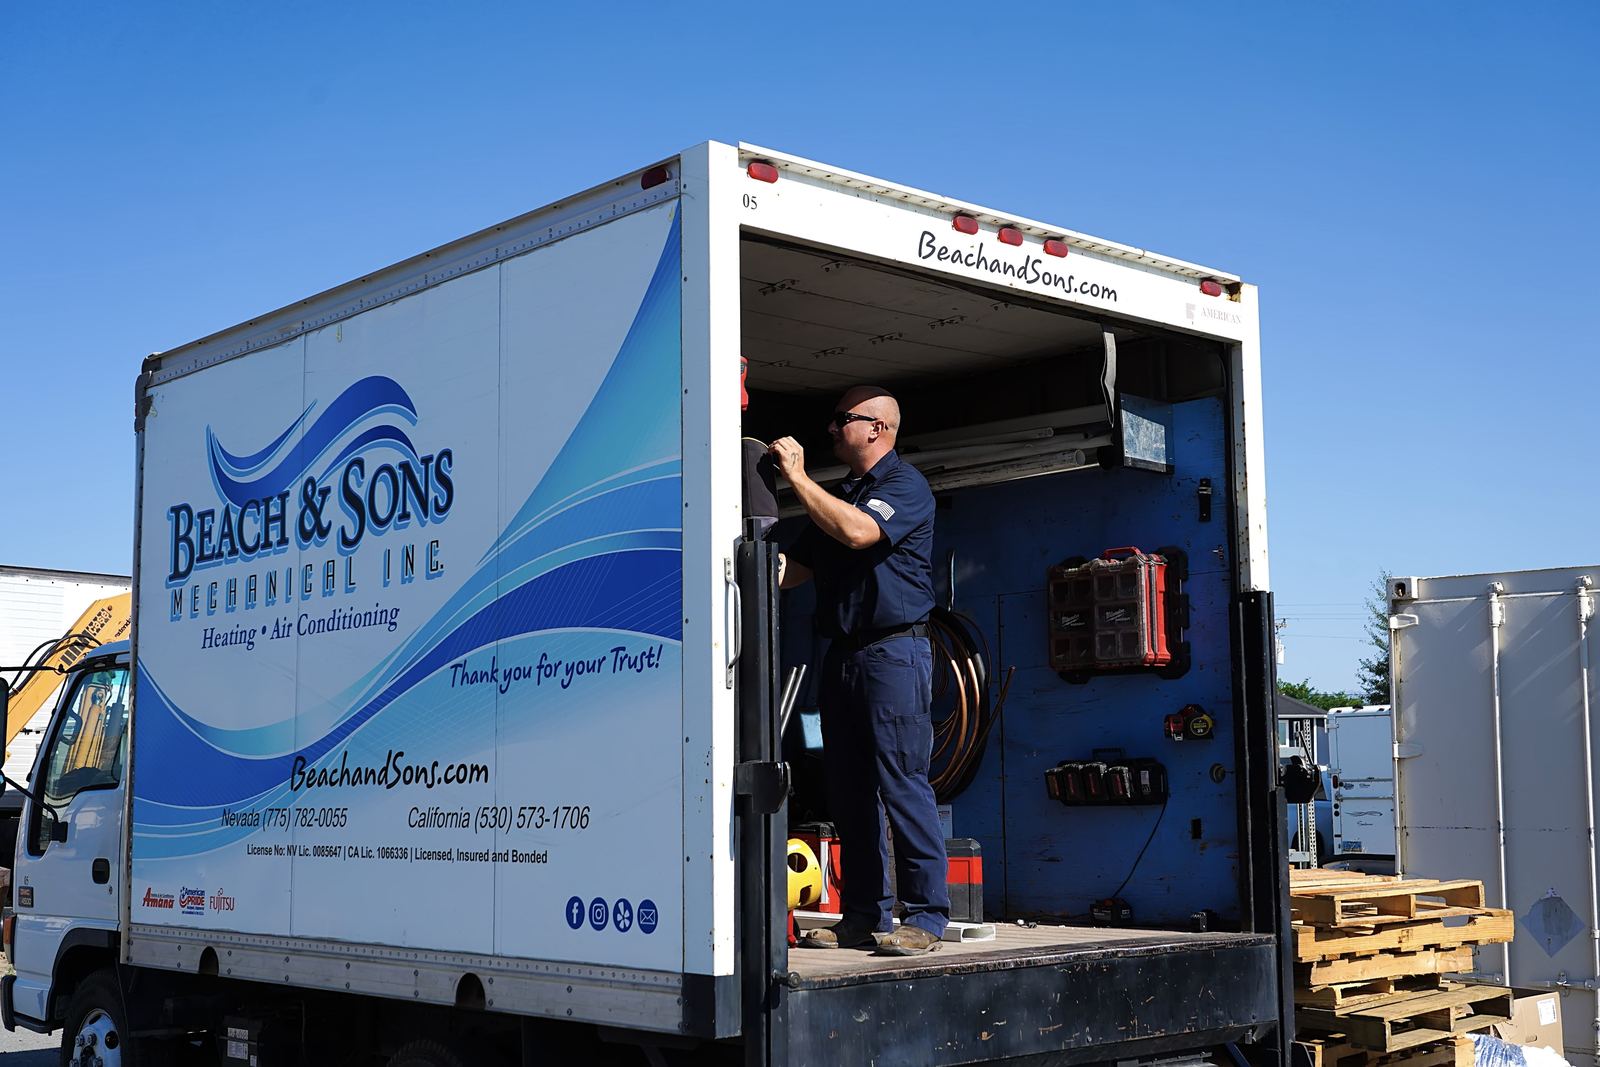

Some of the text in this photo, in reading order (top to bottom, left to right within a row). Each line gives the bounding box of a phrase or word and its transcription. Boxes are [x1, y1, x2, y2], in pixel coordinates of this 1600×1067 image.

[742, 193, 758, 210] 05
[917, 230, 1119, 303] BeachandSons.com
[1201, 306, 1242, 325] AMERICAN
[166, 448, 455, 587] BEACH & SONS
[170, 539, 446, 621] MECHANICAL INC.
[200, 624, 257, 651] Heating
[269, 616, 294, 641] Air
[296, 602, 401, 633] Conditioning
[449, 643, 664, 695] Thank you for your Trust!
[290, 749, 489, 792] BeachandSons.com
[221, 807, 349, 832] Nevada (775) 782-0055
[408, 805, 591, 835] California (530) 573-1706
[246, 844, 273, 857] License
[274, 844, 285, 857] No:
[286, 844, 298, 857] NV
[298, 845, 311, 857] Lic.
[312, 845, 342, 859] 0085647
[347, 845, 359, 859] CA
[361, 846, 375, 859] Lic.
[376, 846, 409, 860] 1066336
[414, 847, 455, 863] Licensed,
[456, 848, 490, 862] Insured
[491, 849, 509, 863] and
[511, 849, 548, 864] Bonded
[142, 887, 175, 909] Amana
[184, 888, 206, 897] American
[186, 896, 205, 906] PRIDE
[209, 892, 235, 914] FUJITSU
